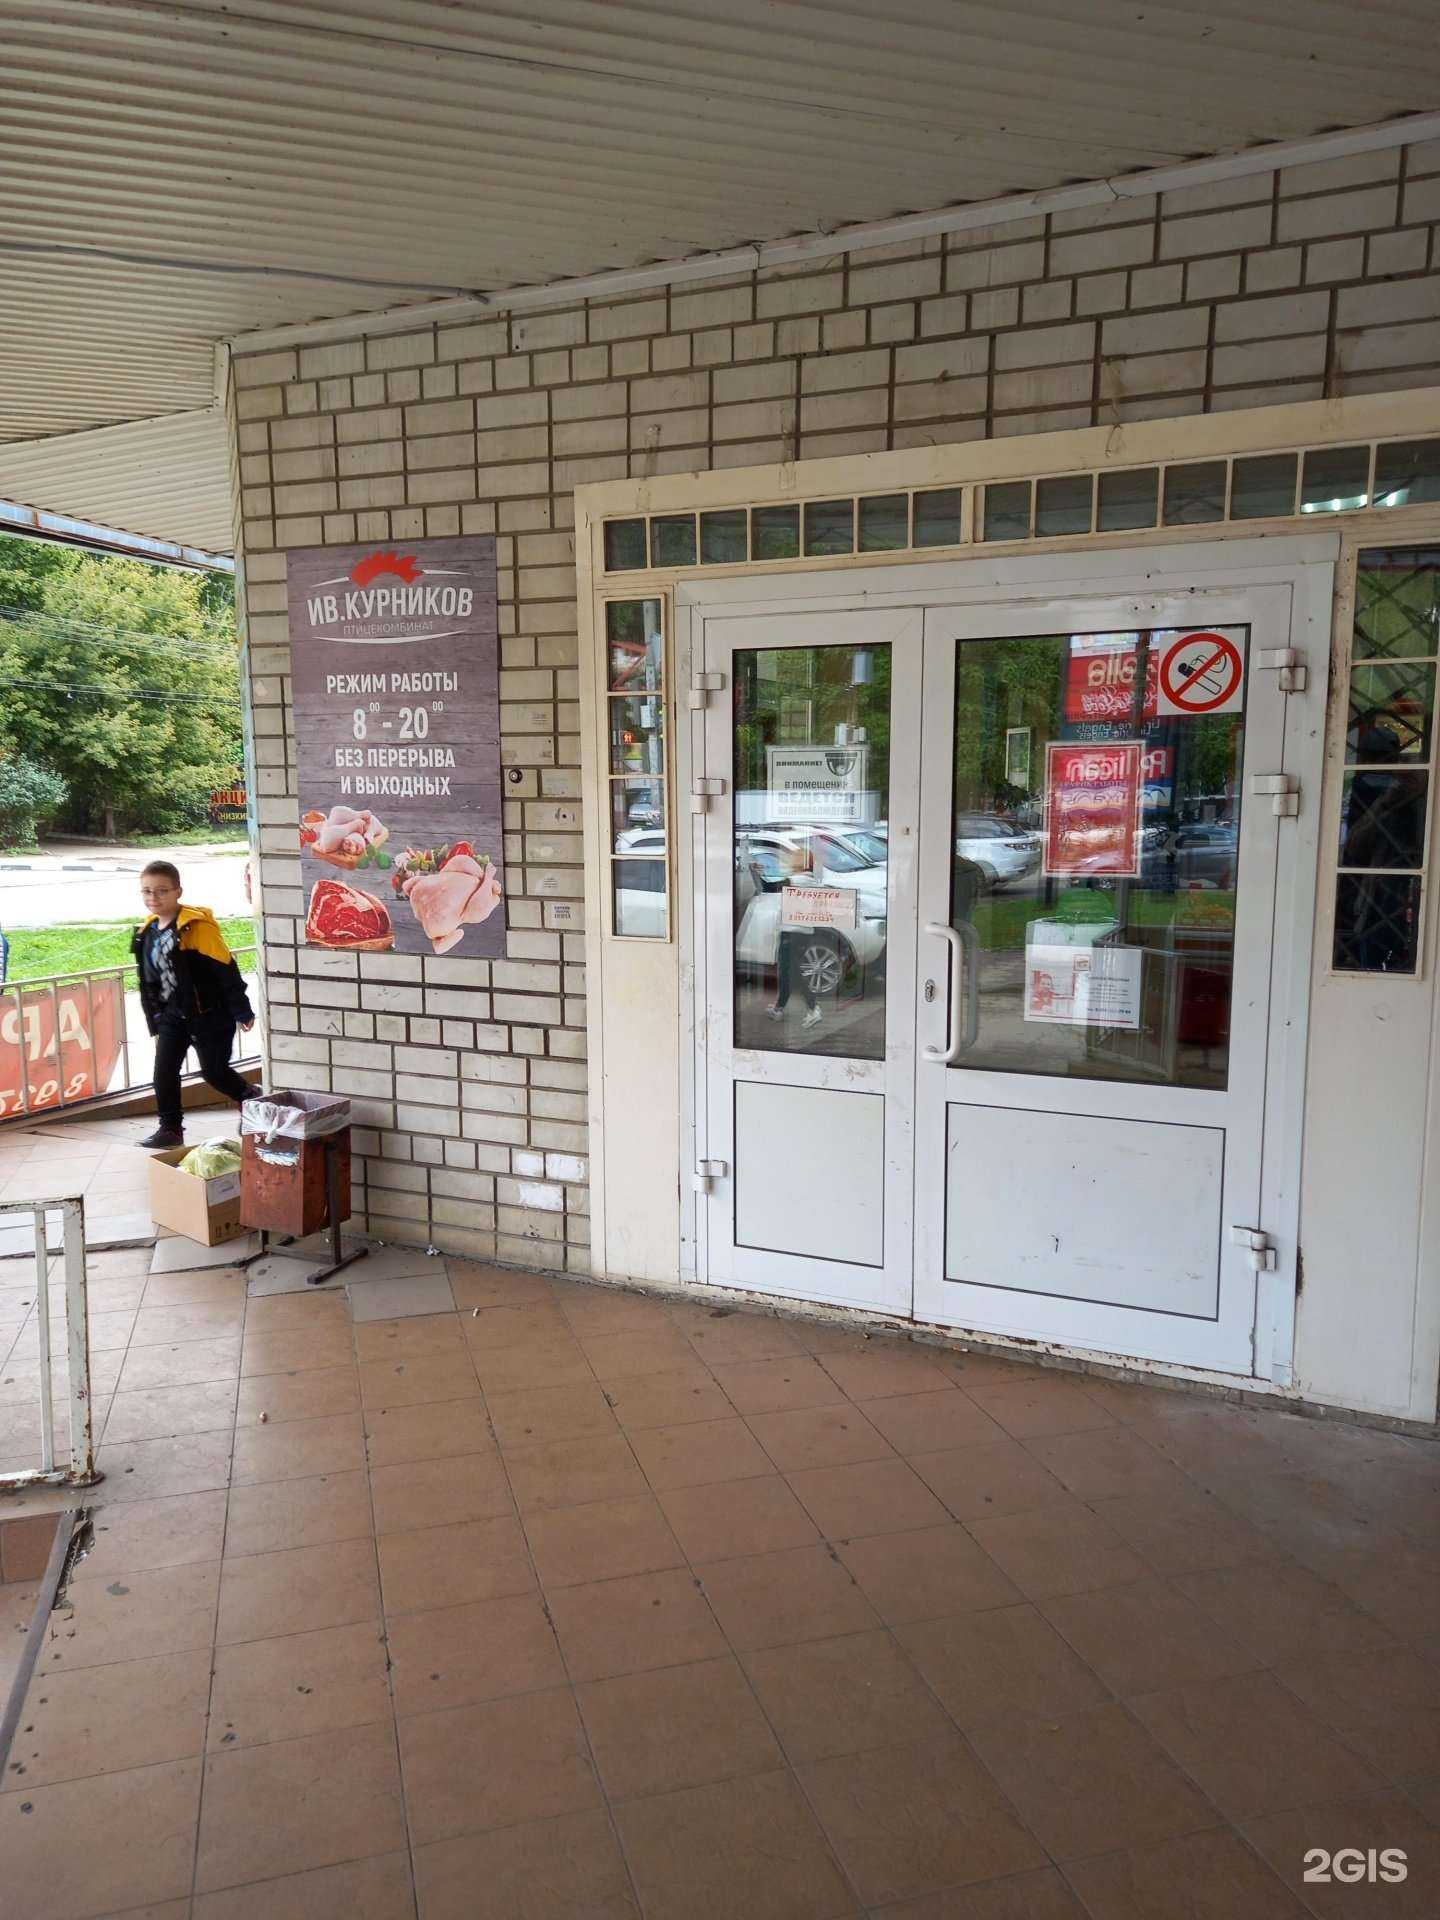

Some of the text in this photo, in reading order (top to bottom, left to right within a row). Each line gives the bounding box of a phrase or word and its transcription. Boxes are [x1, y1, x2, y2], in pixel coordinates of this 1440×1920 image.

[307, 587, 474, 626] ИВ.КУРНИКОВ
[343, 620, 433, 637] ПТИЦЕКОМБИНАТ
[326, 671, 458, 694] РЕЖИМ РАБОТЫ
[335, 748, 456, 768] БЕЗ ПЕРЕРЫВА
[340, 775, 452, 798] И ВЫХОДНЫХ
